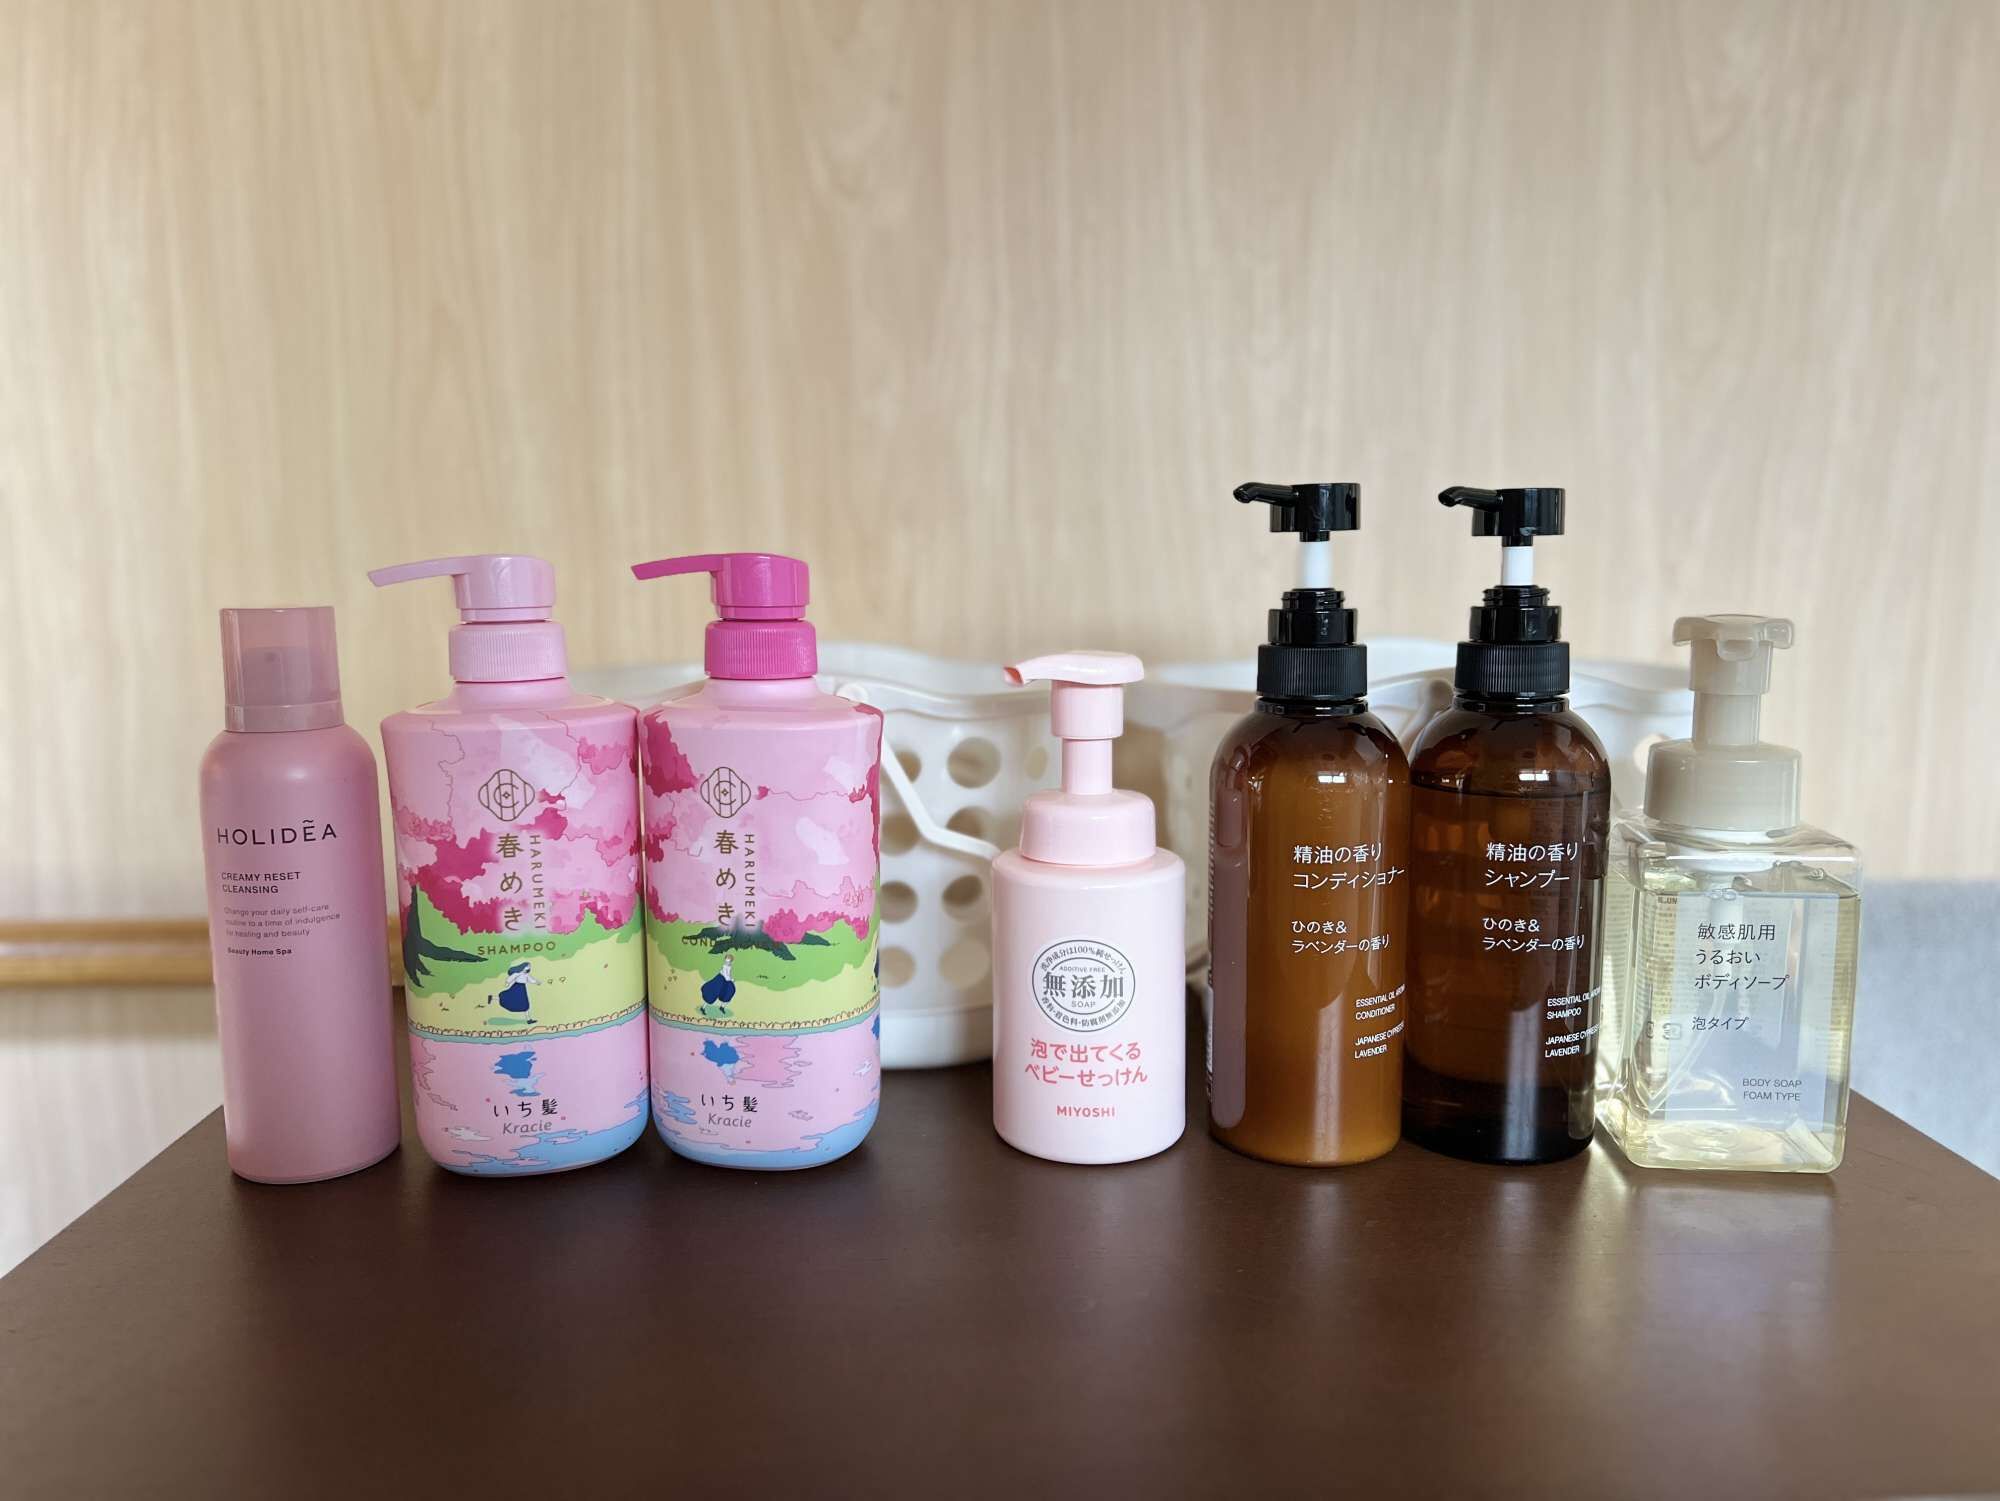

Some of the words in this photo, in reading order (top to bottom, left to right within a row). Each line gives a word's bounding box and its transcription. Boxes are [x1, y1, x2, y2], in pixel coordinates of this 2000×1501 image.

[1293, 842, 1382, 864] 精油の香り
[1486, 841, 1579, 862] 精油の香り
[221, 872, 260, 882] CREAMY
[264, 871, 301, 881] RESET
[496, 833, 524, 931] 春めき
[529, 834, 547, 929] HARUMEKI
[714, 829, 739, 927] 春めき
[744, 834, 755, 927] HARUMEKI
[1293, 866, 1404, 890] コンディショナー
[1484, 868, 1570, 889] シャンプー
[222, 884, 279, 894] CLEANSING
[224, 906, 249, 917] Change
[252, 910, 268, 918] your
[270, 907, 290, 917] daily
[265, 919, 283, 927] time
[296, 913, 340, 924] indulgence
[1291, 919, 1347, 935] ひのき&
[1482, 917, 1541, 933] ひのき&
[1697, 923, 1776, 941] 敏感肌用
[263, 930, 279, 938] and
[281, 929, 310, 938] beauty
[477, 941, 556, 956] SHAMPOO
[1291, 934, 1390, 954] ラベンダーの香り
[1482, 934, 1585, 952] ラベンダーの香り
[227, 947, 250, 956] Beauty
[251, 948, 274, 956] Home
[276, 948, 292, 957] Spa
[1695, 948, 1761, 965] うるおい
[1059, 965, 1088, 973] ADDITIVE
[1042, 971, 1124, 999] 無添加
[1694, 972, 1790, 991] ボディソープ
[1071, 1000, 1096, 1008] SOAP
[1355, 994, 1389, 1008] ESSENTIAL
[1388, 990, 1396, 1000] OIL
[1547, 995, 1582, 1007] ESSENTIAL
[1582, 991, 1590, 1001] OIL
[1355, 1003, 1396, 1021] CONDITIONER
[1546, 1007, 1582, 1020] SHAMPOO
[1692, 1015, 1749, 1031] 泡タイプ
[1355, 1031, 1387, 1047] JAPANESE
[1545, 1032, 1580, 1046] JAPANESE
[1030, 1037, 1142, 1063] 泡で出てくる
[1354, 1044, 1388, 1059] LAVENDER
[1544, 1045, 1580, 1058] LAVENDER
[1025, 1063, 1148, 1087] ベビーせっけん
[1742, 1078, 1770, 1088] BODY
[1773, 1079, 1802, 1088] SOAP
[701, 1093, 758, 1113] いち髪
[1743, 1091, 1772, 1101] FOAM
[1775, 1092, 1801, 1102] TYPE
[493, 1098, 558, 1117] いち髪
[1056, 1105, 1116, 1118] MIYOSHI
[502, 1120, 553, 1135] Kracie
[708, 1113, 752, 1128] Kracie
